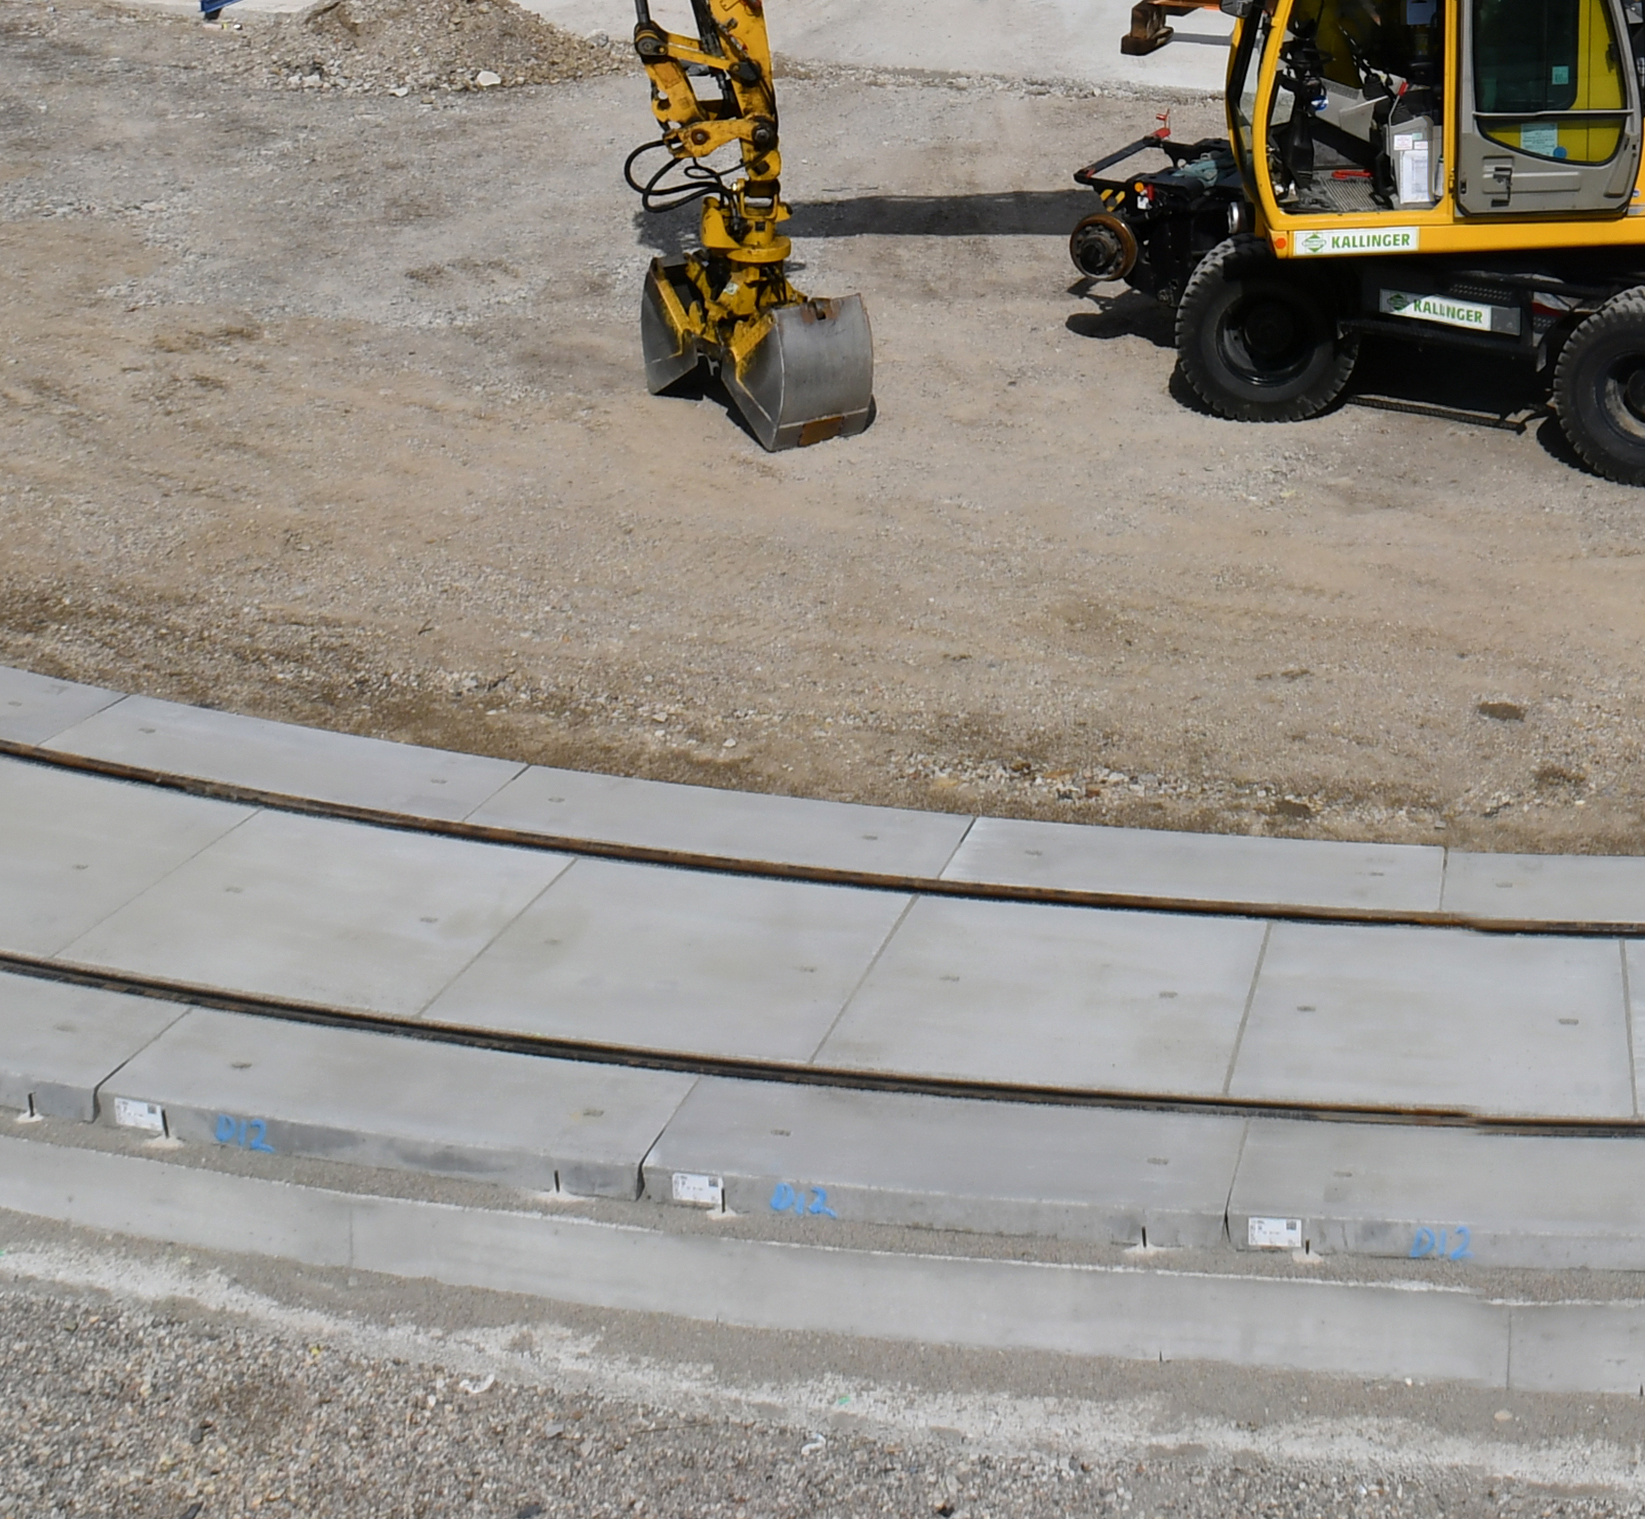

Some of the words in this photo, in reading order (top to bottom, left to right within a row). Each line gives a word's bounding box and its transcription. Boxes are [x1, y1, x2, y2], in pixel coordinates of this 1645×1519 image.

[1331, 233, 1411, 249] KALLINGER
[214, 1112, 276, 1154] D12
[1409, 1225, 1475, 1262] D12
